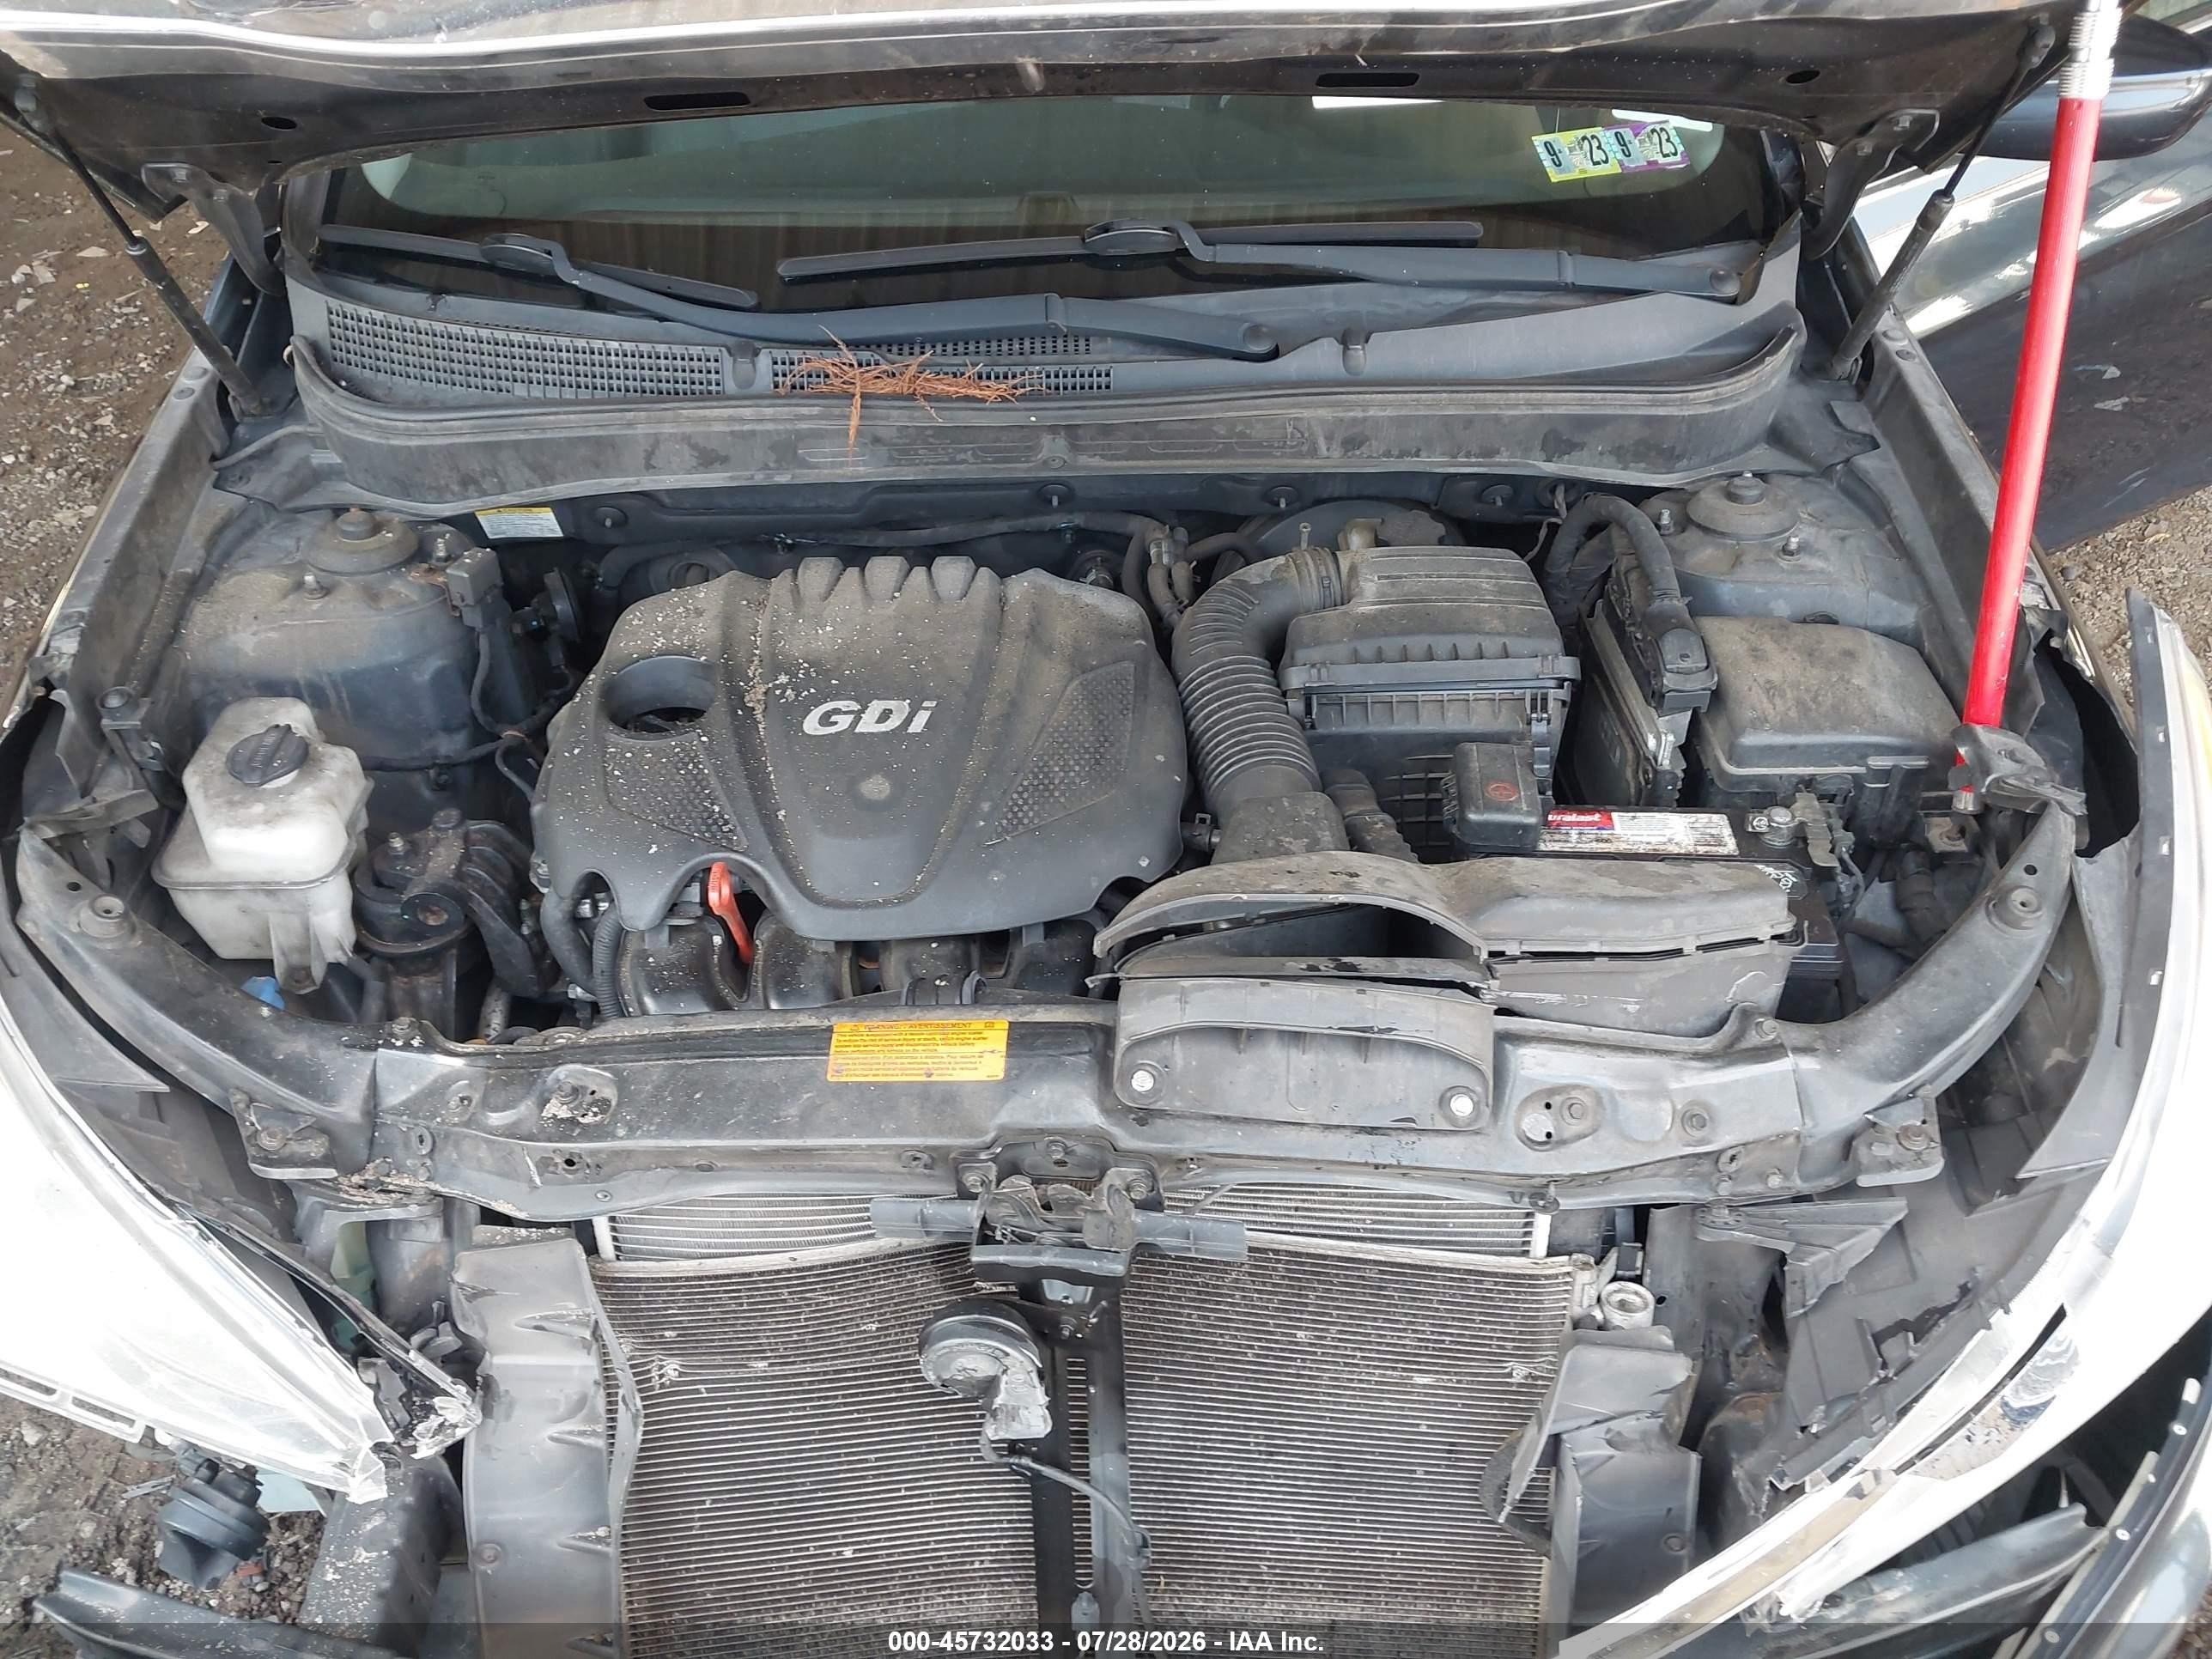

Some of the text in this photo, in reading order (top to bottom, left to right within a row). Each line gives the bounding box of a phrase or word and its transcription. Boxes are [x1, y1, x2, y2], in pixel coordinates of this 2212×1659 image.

[1543, 141, 1562, 167] 9
[1581, 134, 1609, 167] 23
[1614, 131, 1632, 158] 9
[1650, 126, 1679, 158] 23
[802, 700, 938, 735] GDi
[1547, 813, 1602, 822] uralast
